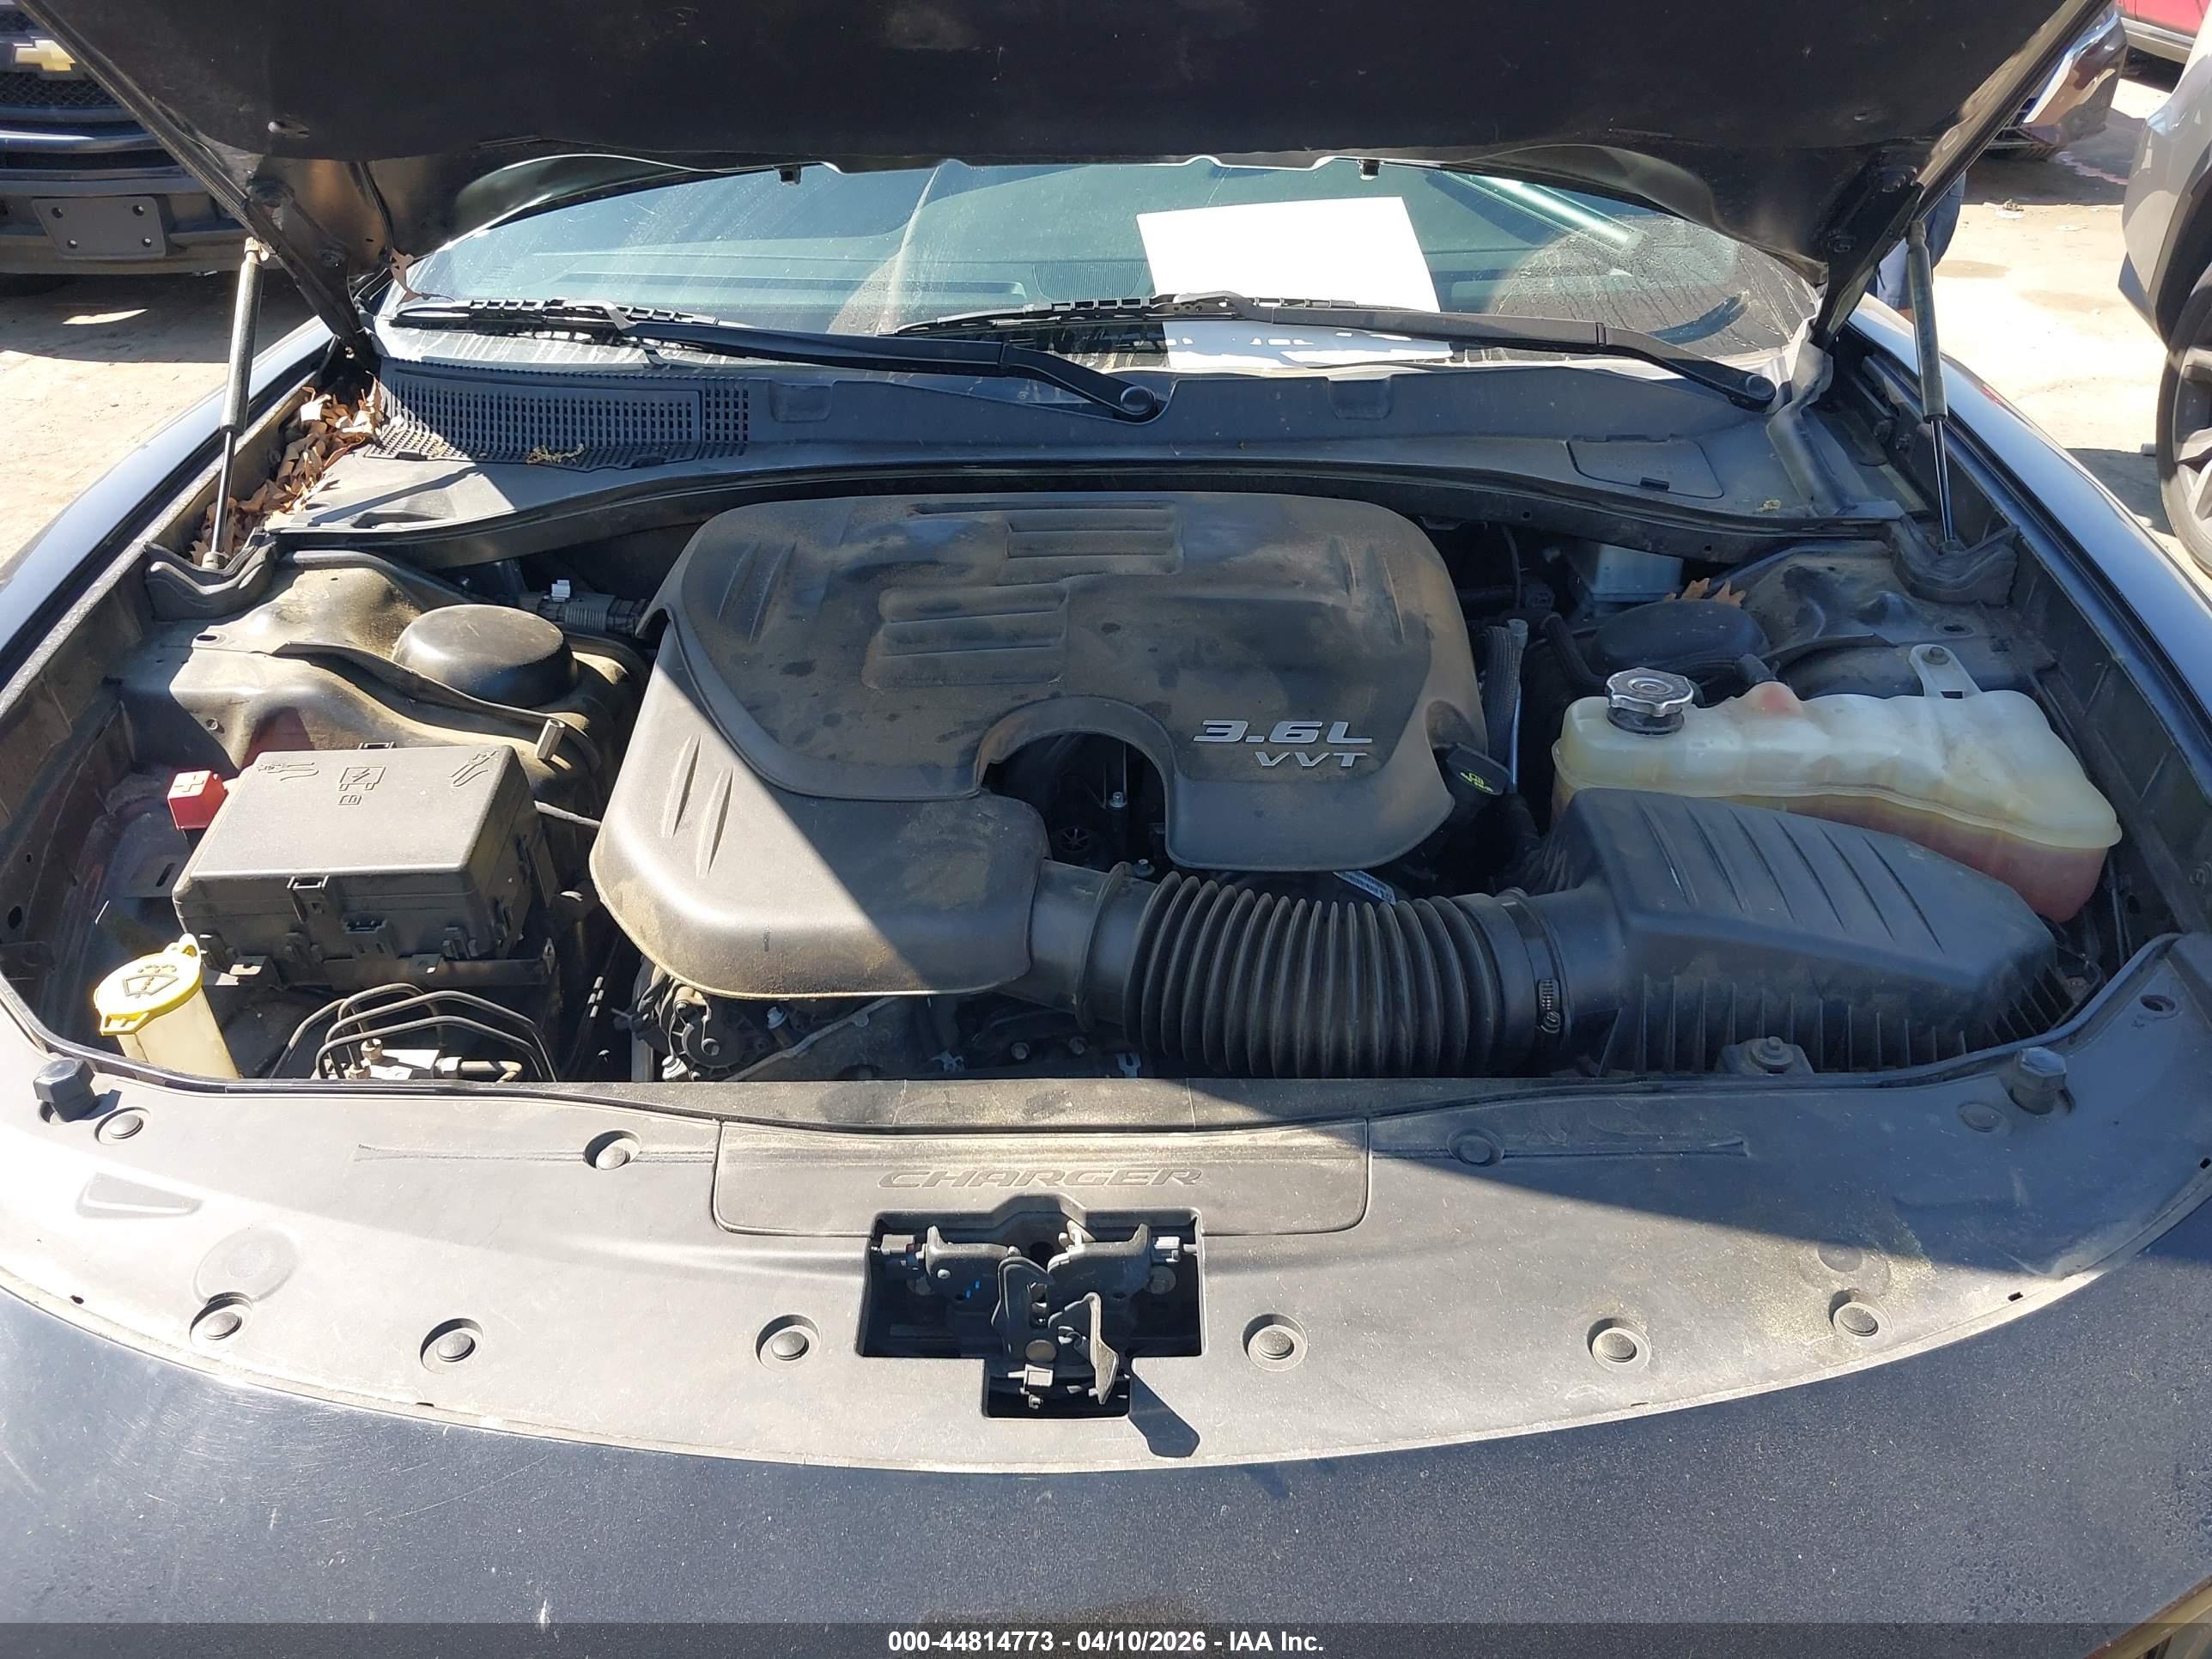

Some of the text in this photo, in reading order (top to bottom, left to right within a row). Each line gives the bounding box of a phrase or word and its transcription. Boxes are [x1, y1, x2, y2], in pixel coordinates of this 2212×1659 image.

[1194, 720, 1373, 744] 3.6L
[1255, 751, 1368, 767] VVT
[878, 1168, 1201, 1188] CHARGER
